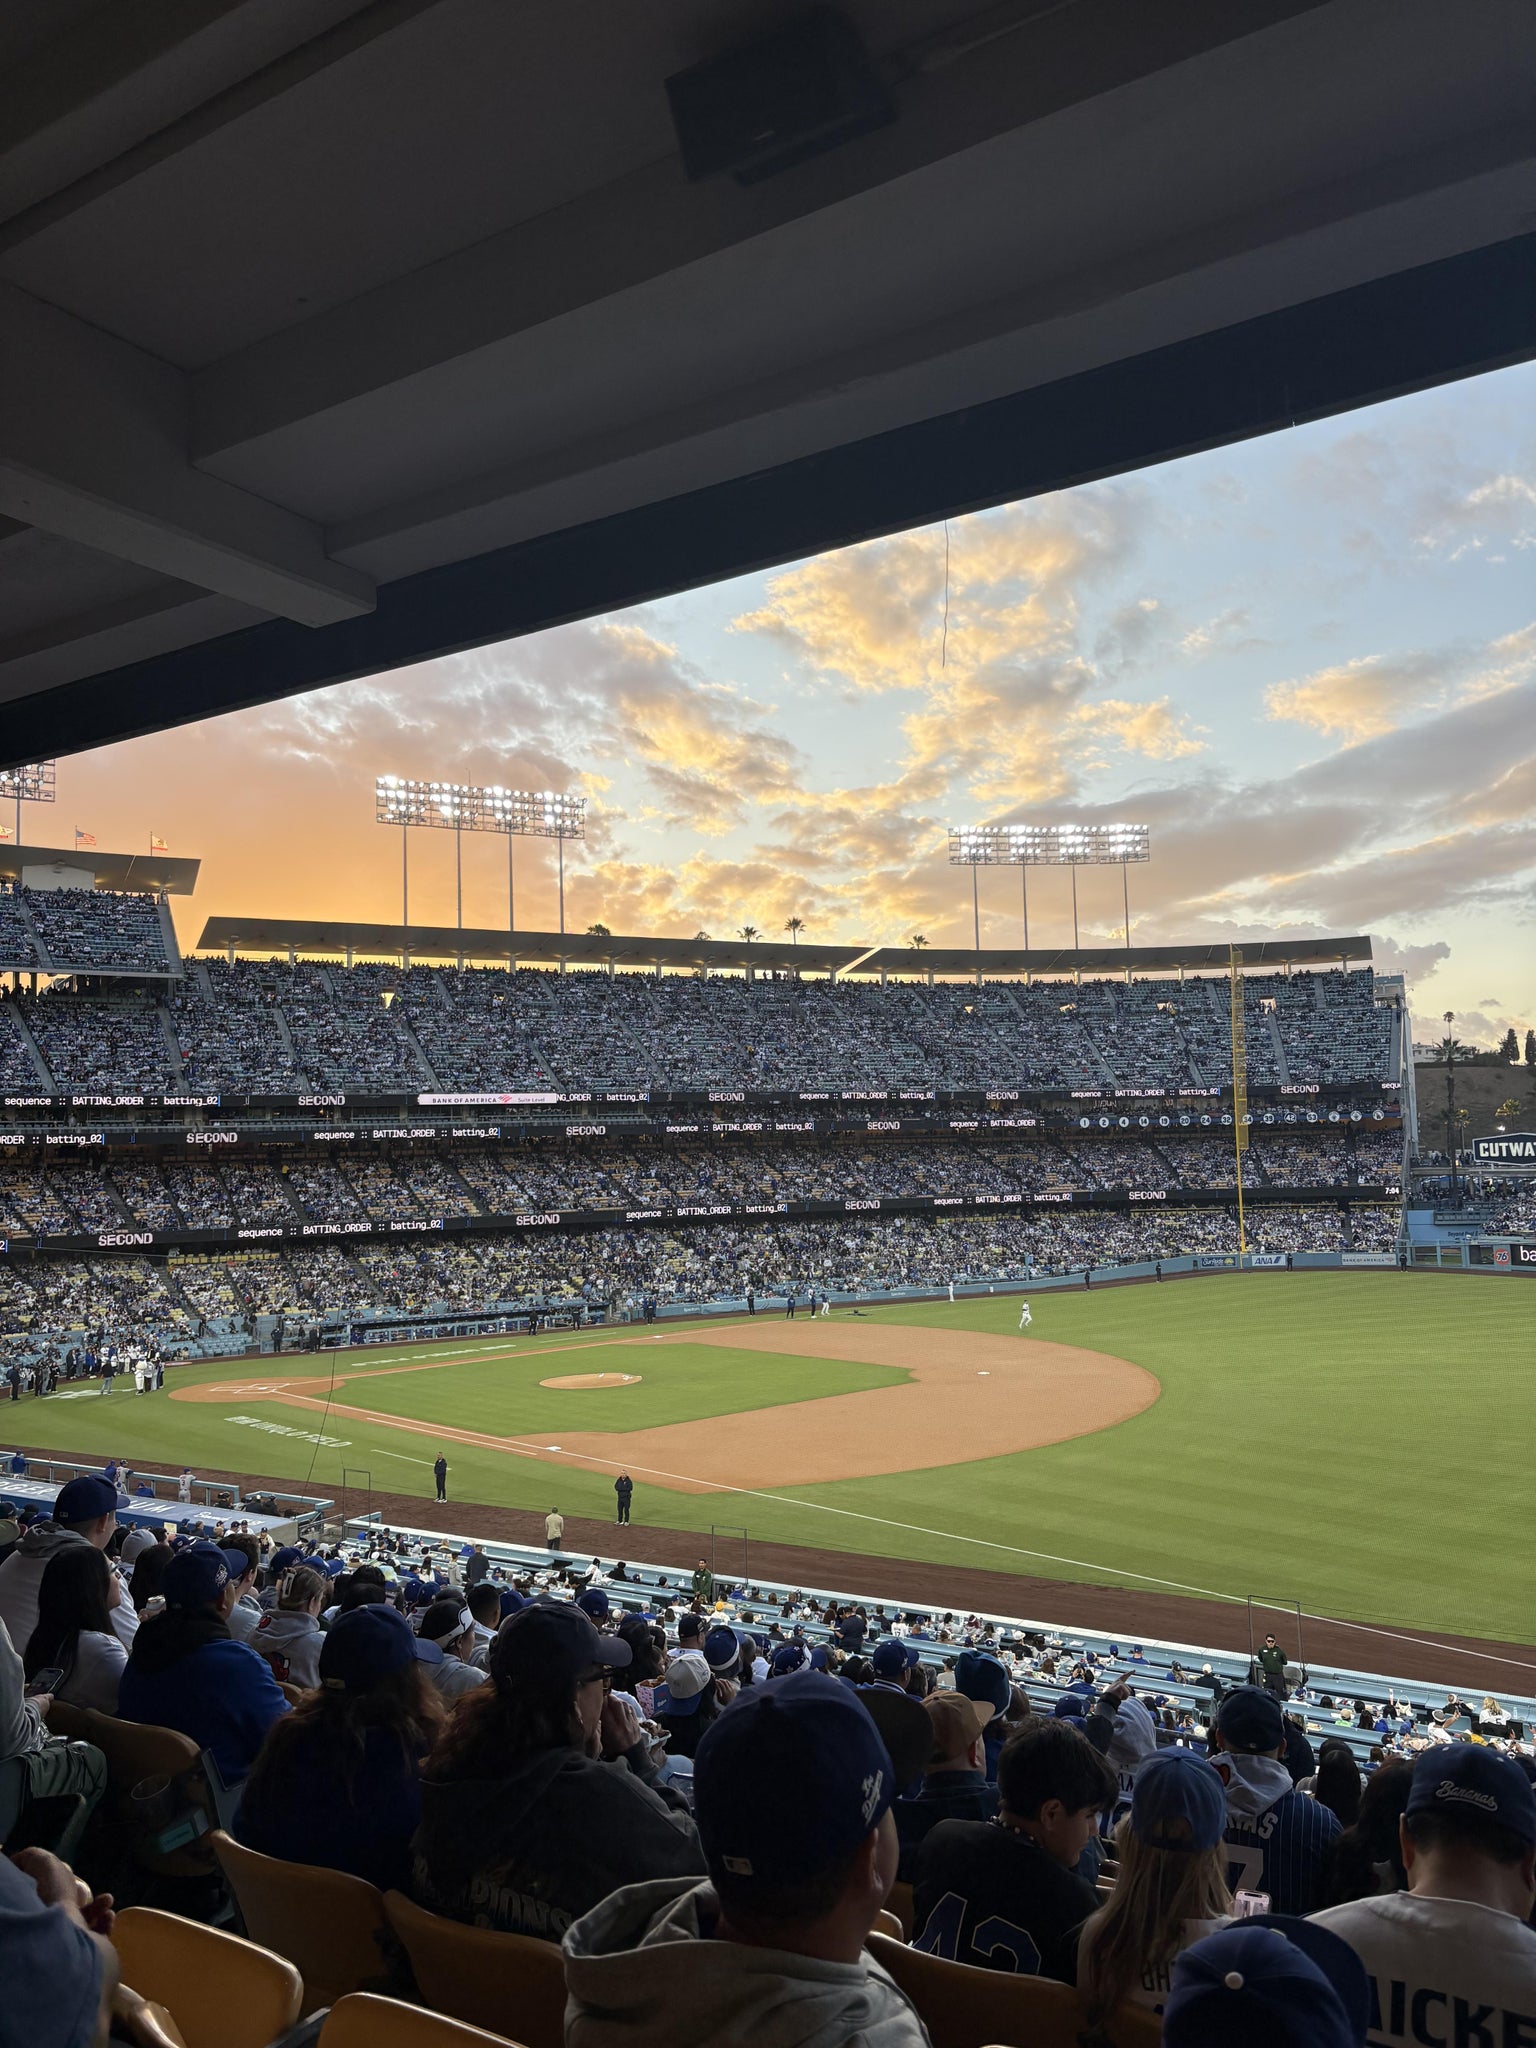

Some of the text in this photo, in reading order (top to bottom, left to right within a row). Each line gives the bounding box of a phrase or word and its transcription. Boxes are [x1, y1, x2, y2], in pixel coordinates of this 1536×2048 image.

[1281, 1084, 1319, 1093] SECOND
[298, 1094, 345, 1105] SECOND
[709, 1091, 744, 1101] SECOND
[986, 1090, 1020, 1099] SECOND
[5, 1098, 51, 1107] sequence
[73, 1097, 143, 1105] BATTING_ORDER
[713, 1123, 762, 1131] BATTING_ORDER
[868, 1120, 900, 1130] SECOND
[991, 1118, 1035, 1127] BATTING_ORDER
[314, 1132, 354, 1140] sequence
[373, 1129, 435, 1138] BATTING_ORDER
[566, 1126, 605, 1137] SECOND
[0, 1135, 24, 1144] RDER
[187, 1133, 237, 1143] SECOND
[976, 1195, 1021, 1203] BATTING_ORDER
[1129, 1191, 1166, 1199] SECOND
[845, 1199, 880, 1209] SECOND
[627, 1211, 661, 1219] sequence
[677, 1205, 731, 1216] BATTING_ORDER
[515, 1213, 560, 1225] SECOND
[238, 1229, 282, 1238] sequence
[303, 1223, 371, 1234] BATTING_ORDER
[99, 1232, 152, 1246] SECOND
[1496, 1251, 1508, 1261] 76
[1435, 1780, 1498, 1811] Bananas
